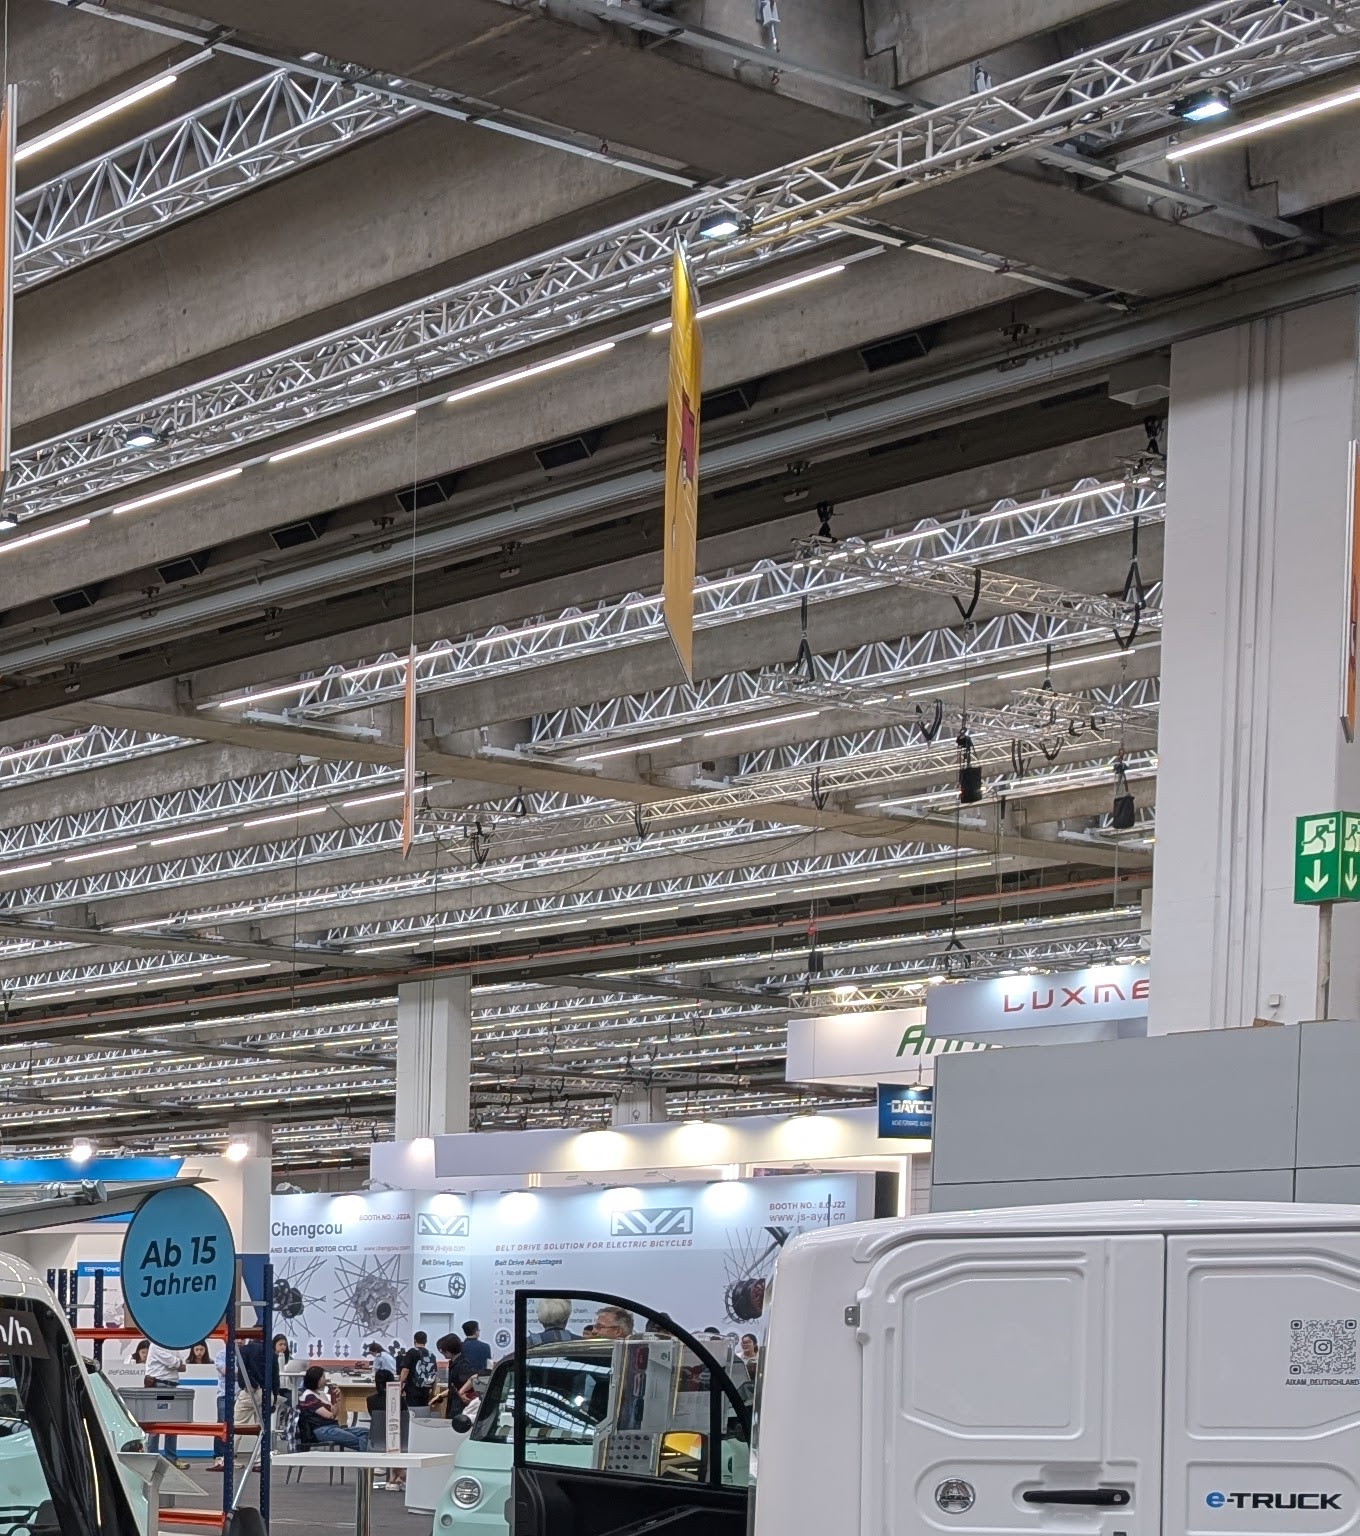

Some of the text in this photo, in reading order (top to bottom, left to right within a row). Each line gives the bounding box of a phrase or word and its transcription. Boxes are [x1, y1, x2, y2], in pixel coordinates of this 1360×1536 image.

[271, 1221, 343, 1239] Chengcou
[419, 1214, 468, 1235] AYA
[612, 1210, 692, 1235] AYA
[140, 1235, 218, 1270] Ab 15
[517, 1243, 541, 1251] DRIVE
[606, 1240, 647, 1248] ELECTRIC
[649, 1239, 693, 1247] BICYCLES
[139, 1271, 217, 1298] Jahren
[1205, 1491, 1343, 1511] e-TRUCK
